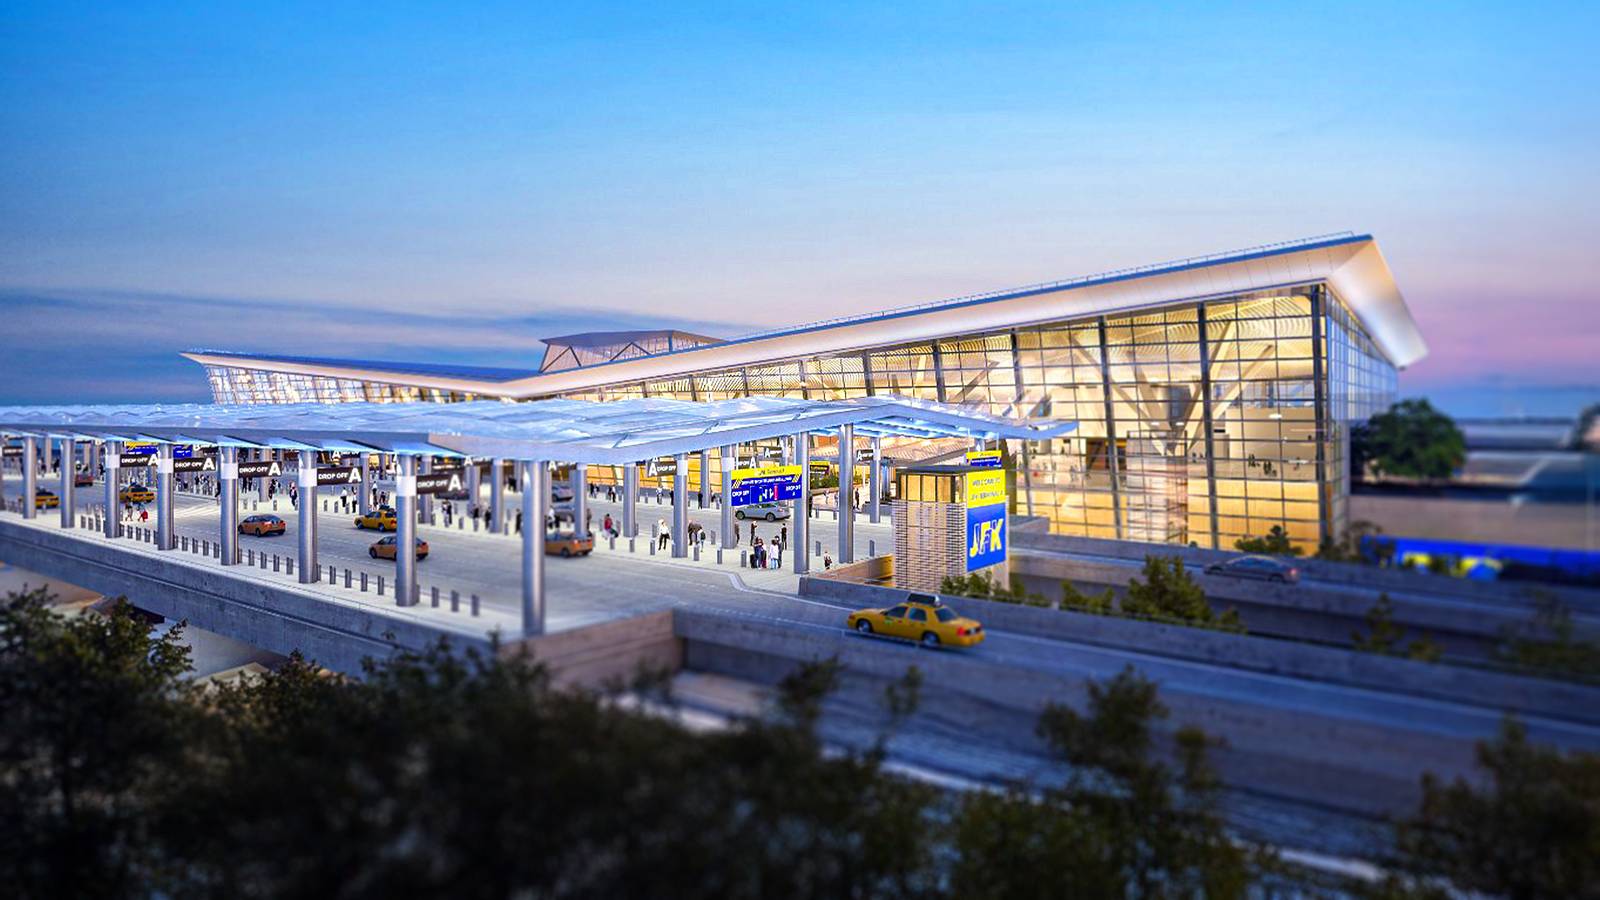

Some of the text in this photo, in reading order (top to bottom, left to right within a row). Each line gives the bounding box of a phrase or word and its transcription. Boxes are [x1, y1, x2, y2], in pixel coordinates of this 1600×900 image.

[148, 454, 158, 465] A
[202, 457, 215, 470] A
[268, 462, 281, 476] A
[348, 467, 361, 483] A
[648, 462, 658, 476] A
[448, 474, 462, 491] A
[970, 518, 1004, 558] JFK
